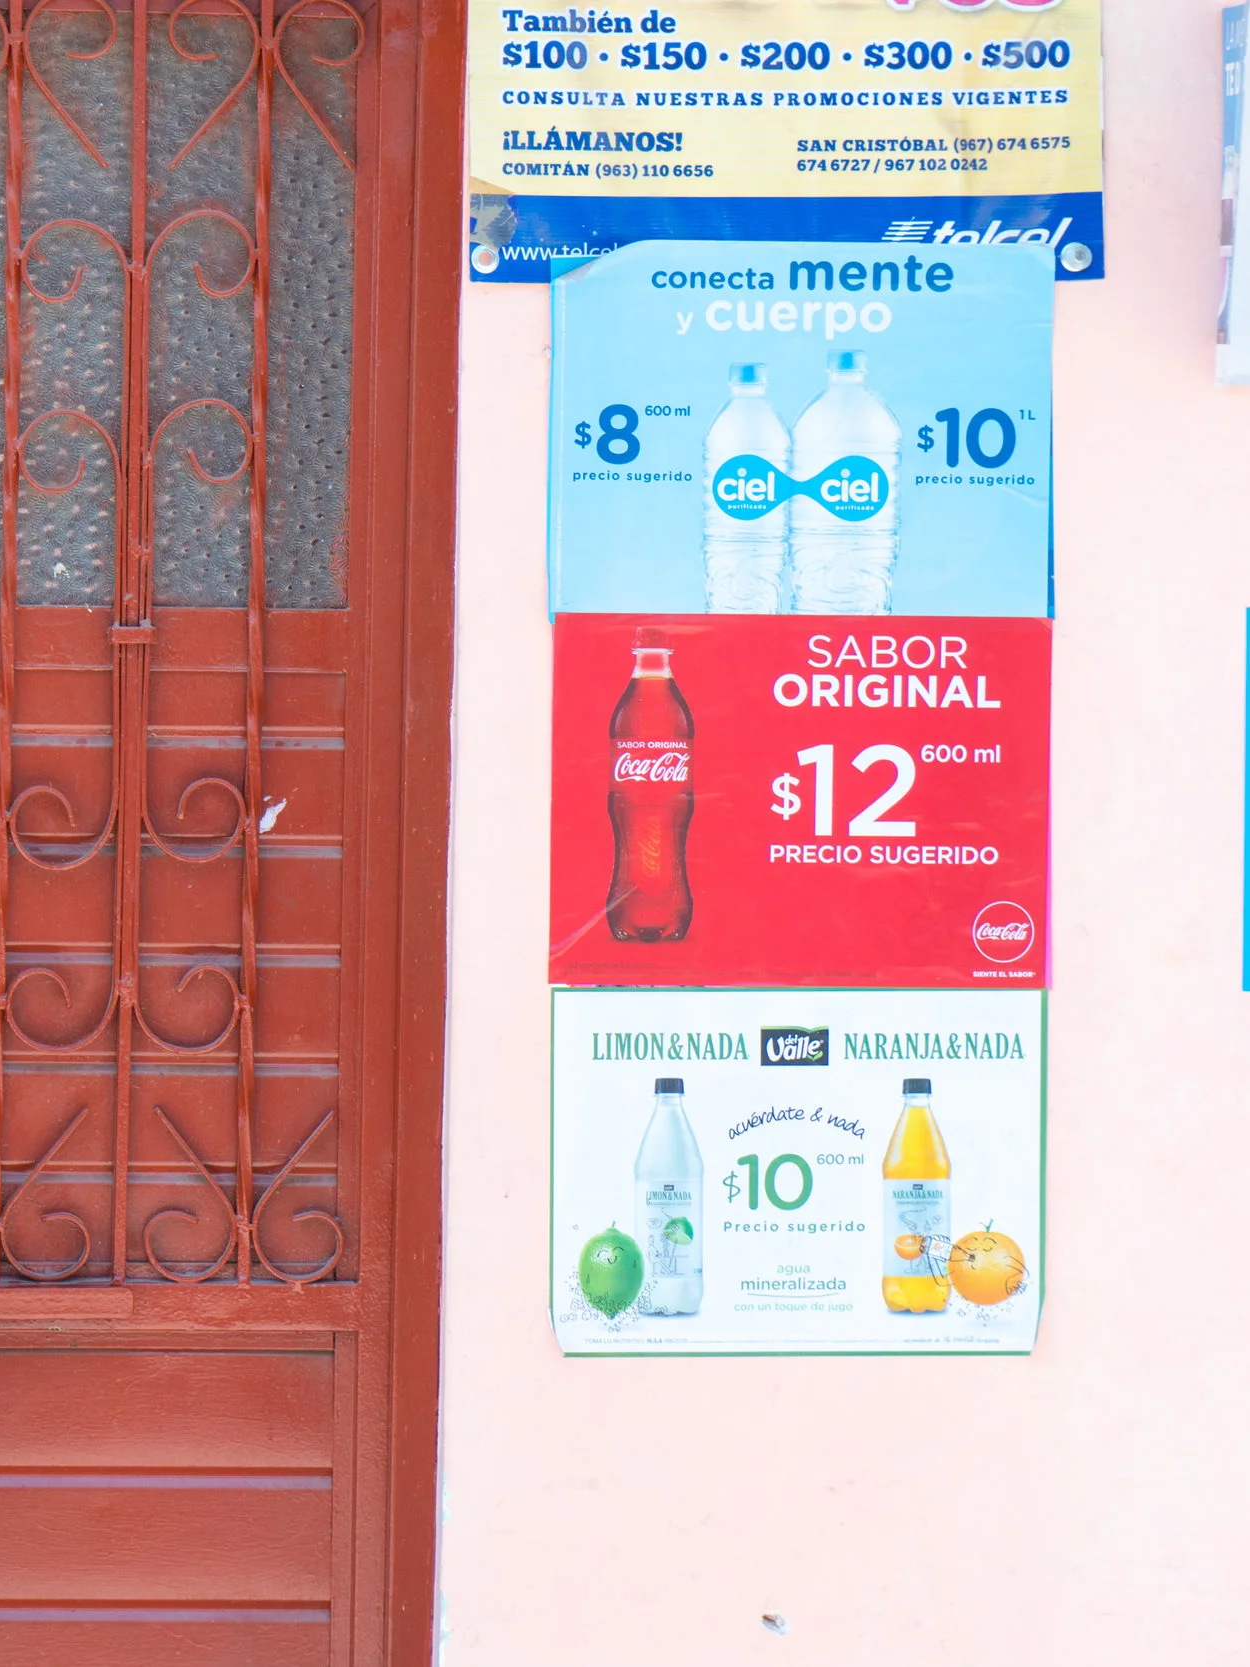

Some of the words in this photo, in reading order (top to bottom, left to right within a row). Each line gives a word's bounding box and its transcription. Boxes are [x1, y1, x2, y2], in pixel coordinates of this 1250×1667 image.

[503, 9, 632, 33] También
[641, 10, 676, 33] de
[503, 41, 587, 69] $100
[621, 42, 707, 70] $150
[741, 42, 830, 70] $200
[865, 41, 952, 70] $300
[982, 40, 1070, 69] $500
[503, 91, 625, 106] CONSULTA
[636, 93, 762, 106] NUESTRAS
[774, 92, 942, 106] PROMOCIONES
[952, 90, 1067, 105] VIGENTES
[502, 127, 683, 153] ¡LLÁMANOS!
[797, 140, 836, 152] SAN
[843, 137, 948, 151] CRISTÓBAL
[954, 138, 993, 153] (967)
[997, 138, 1026, 150] 674
[1030, 136, 1070, 149] 6575
[503, 161, 589, 176] COMITÁN
[596, 163, 638, 179] (963)
[642, 164, 668, 178] 110
[672, 164, 714, 178] 6656
[797, 160, 826, 171] 674
[831, 159, 870, 171] 6727
[885, 159, 914, 171] 967
[919, 159, 946, 170] 102
[951, 158, 987, 170] 0242
[652, 268, 774, 289] conecta
[790, 255, 954, 292] mente
[677, 312, 693, 335] y
[706, 300, 892, 340] cuerpo
[575, 404, 640, 464] $8
[645, 405, 671, 416] 600
[675, 406, 690, 416] ml
[917, 408, 1016, 468] $10
[573, 470, 620, 482] precio
[627, 471, 692, 483] sugerido
[717, 468, 775, 502] ciel
[820, 468, 879, 503] ciel
[916, 474, 962, 485] precio
[969, 475, 1034, 486] sugerido
[808, 635, 967, 669] SABOR
[773, 674, 1001, 708] ORIGINAL
[613, 751, 690, 784] Coca-Cola
[770, 744, 916, 837] $12
[920, 744, 967, 763] 600
[974, 744, 1000, 763] ml
[770, 845, 862, 864] PRECIO
[870, 846, 999, 865] SUGERIDO
[976, 922, 1030, 941] Coca-Cola
[593, 1033, 748, 1060] LIMON&NADA
[766, 1035, 821, 1062] Valle
[784, 1034, 798, 1045] del
[845, 1033, 1023, 1059] NARANJA&NADA
[729, 1106, 805, 1139] acuérdate
[810, 1107, 822, 1121] &
[827, 1115, 864, 1139] nada
[723, 1154, 813, 1210] $10
[817, 1154, 844, 1165] 600
[849, 1154, 863, 1164] ml
[724, 1221, 778, 1232] Precio
[788, 1221, 865, 1233] sugerido
[777, 1265, 810, 1275] agua
[741, 1277, 846, 1290] mineralizada
[733, 1303, 755, 1312] con
[758, 1303, 772, 1312] un
[775, 1301, 808, 1313] toque
[811, 1301, 825, 1312] de
[827, 1302, 854, 1313] jugo
